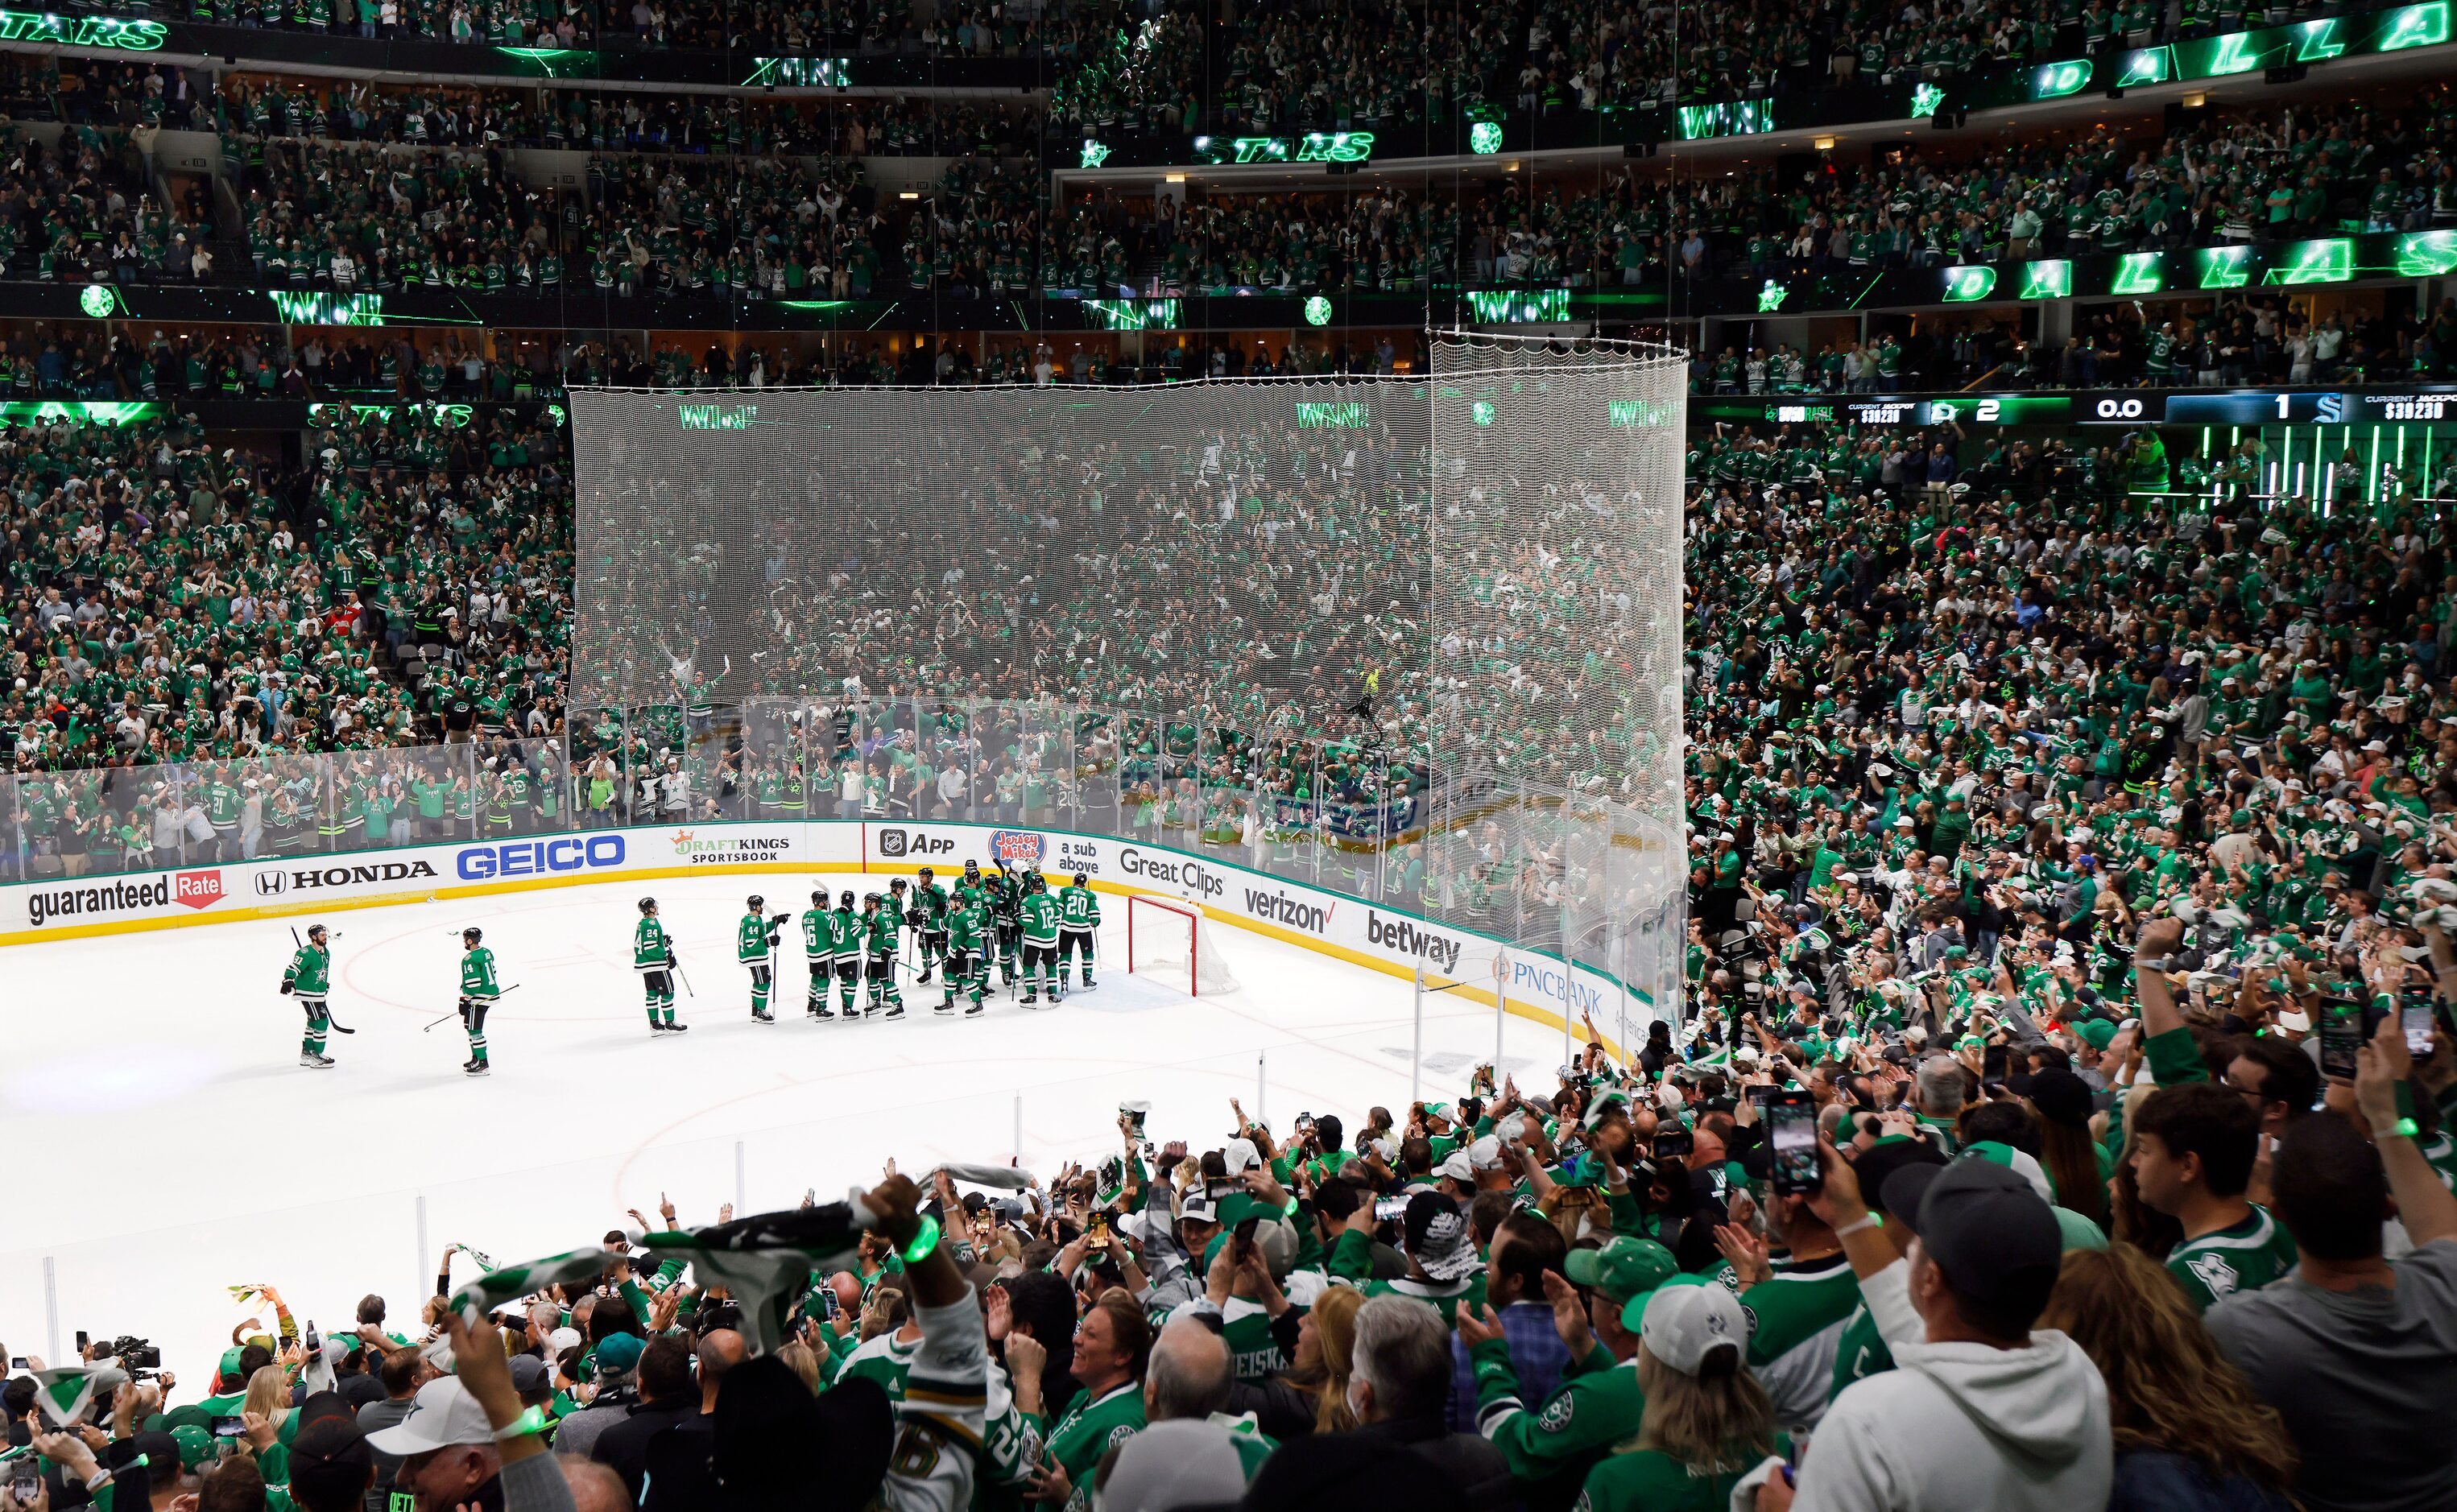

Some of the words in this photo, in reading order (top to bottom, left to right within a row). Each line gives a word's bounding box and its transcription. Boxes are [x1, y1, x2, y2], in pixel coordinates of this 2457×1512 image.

[0, 11, 168, 51] TARS
[2038, 0, 2449, 98] DALLA
[1193, 132, 1374, 163] STARS
[1941, 229, 2457, 302] DALLAS
[1861, 409, 1900, 423] $39230
[1976, 399, 2000, 422] 2
[2097, 399, 2143, 418] 0.0
[2275, 395, 2289, 419] 1
[2385, 403, 2444, 419] $39230
[213, 797, 224, 815] 21
[996, 832, 1039, 850] Jersey
[1061, 843, 1069, 853] a
[1073, 842, 1097, 857] sub
[457, 834, 626, 880] GEICO
[692, 852, 778, 863] SPORTSBOOK
[1059, 856, 1099, 874] above
[292, 861, 437, 889] HONDA
[1120, 848, 1179, 884] Great
[1181, 862, 1223, 899] Clips
[179, 875, 220, 897] Rate
[29, 874, 168, 926] guaranteed
[881, 903, 891, 911] 21
[972, 901, 982, 909] 23
[1066, 895, 1088, 917] 20
[1245, 888, 1325, 934] verizon
[966, 919, 978, 929] 63
[1040, 907, 1055, 929] 12
[647, 929, 658, 938] 24
[748, 926, 759, 935] 44
[635, 932, 643, 955] 4
[1368, 910, 1462, 974] betway
[293, 955, 304, 965] 91
[464, 964, 474, 974] 14
